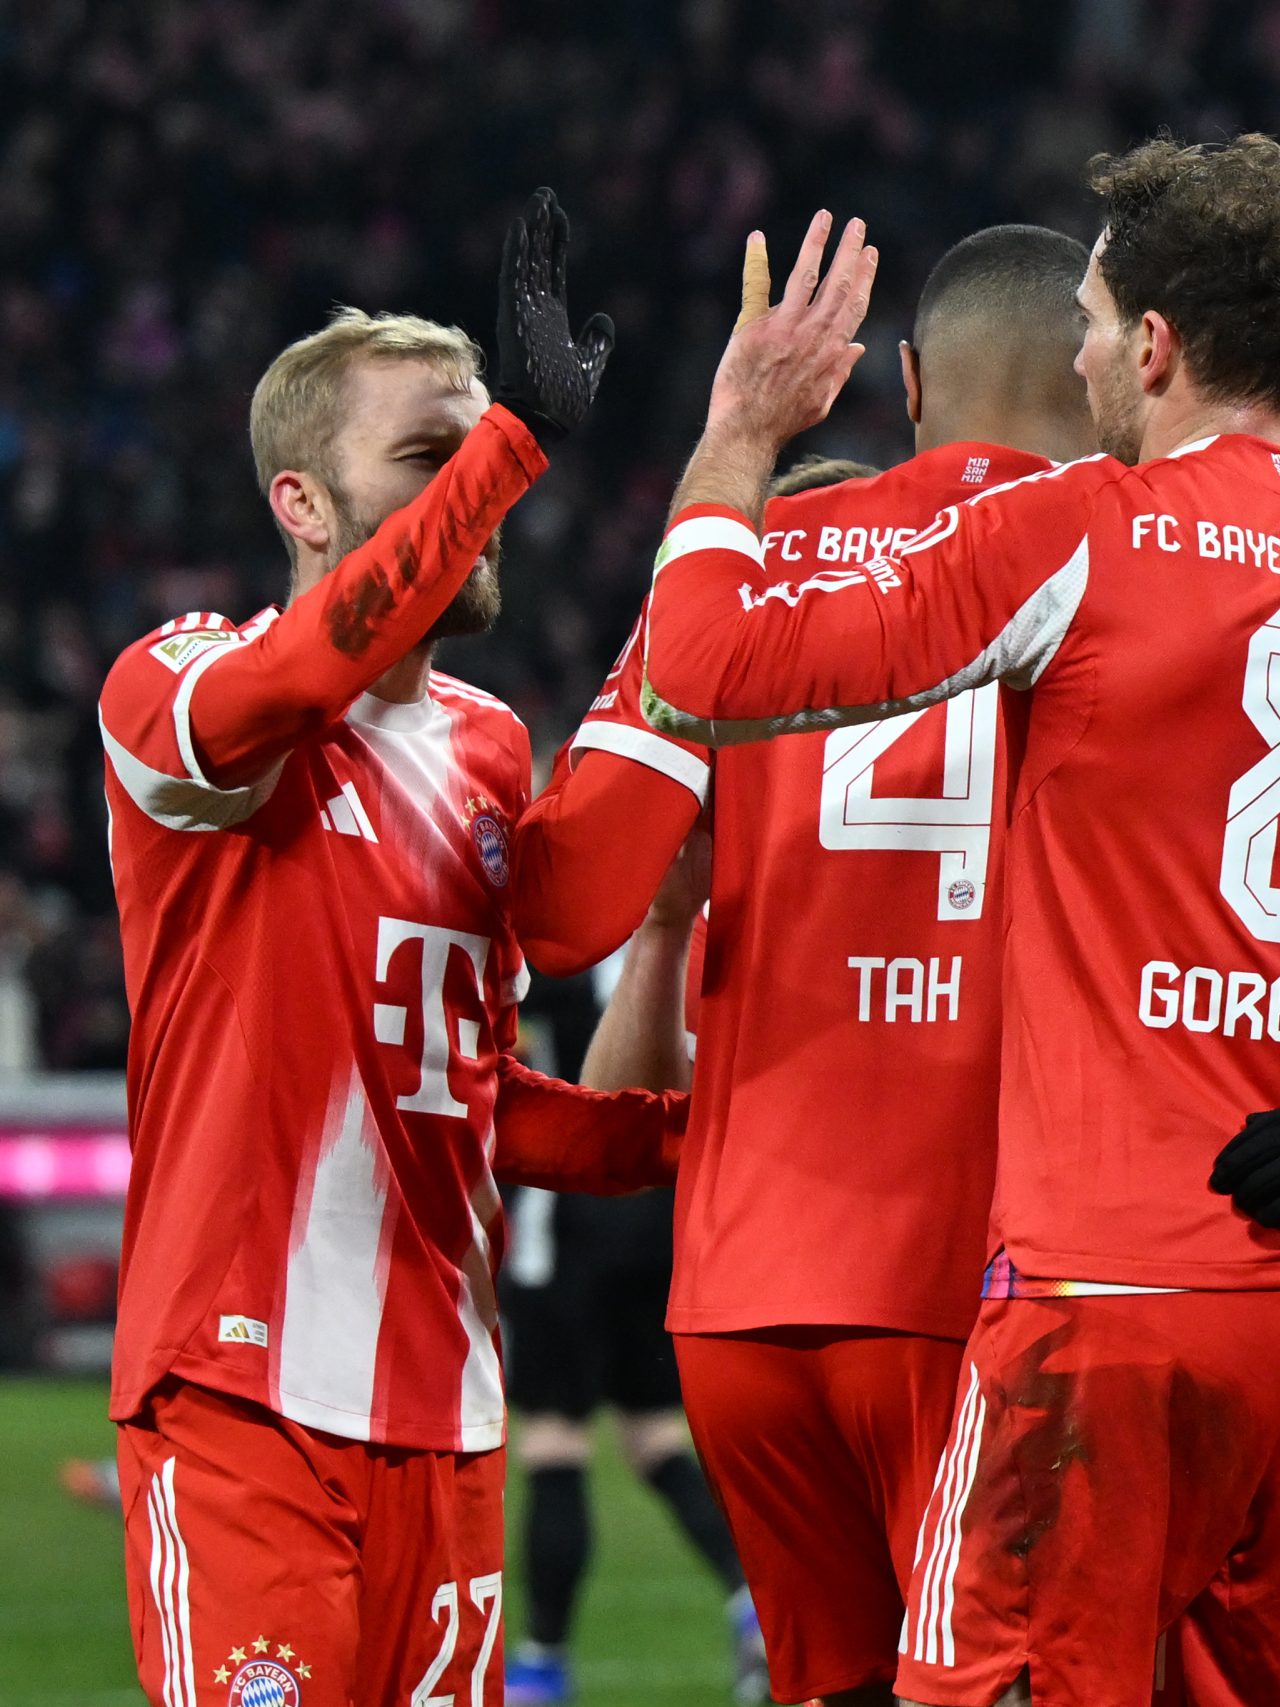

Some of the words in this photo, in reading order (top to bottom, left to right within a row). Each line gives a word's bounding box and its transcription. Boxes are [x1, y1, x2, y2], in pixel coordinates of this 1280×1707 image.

[961, 474, 983, 483] MIA
[964, 466, 987, 475] SAN
[968, 457, 990, 468] MIA
[760, 530, 808, 561] FC
[817, 526, 917, 562] BAYE
[1132, 513, 1182, 553] FC
[819, 679, 999, 921] 4
[847, 956, 963, 1023] TAH
[411, 1571, 503, 1707] 27
[232, 1675, 247, 1693] FC
[246, 1665, 294, 1693] BAYERN
